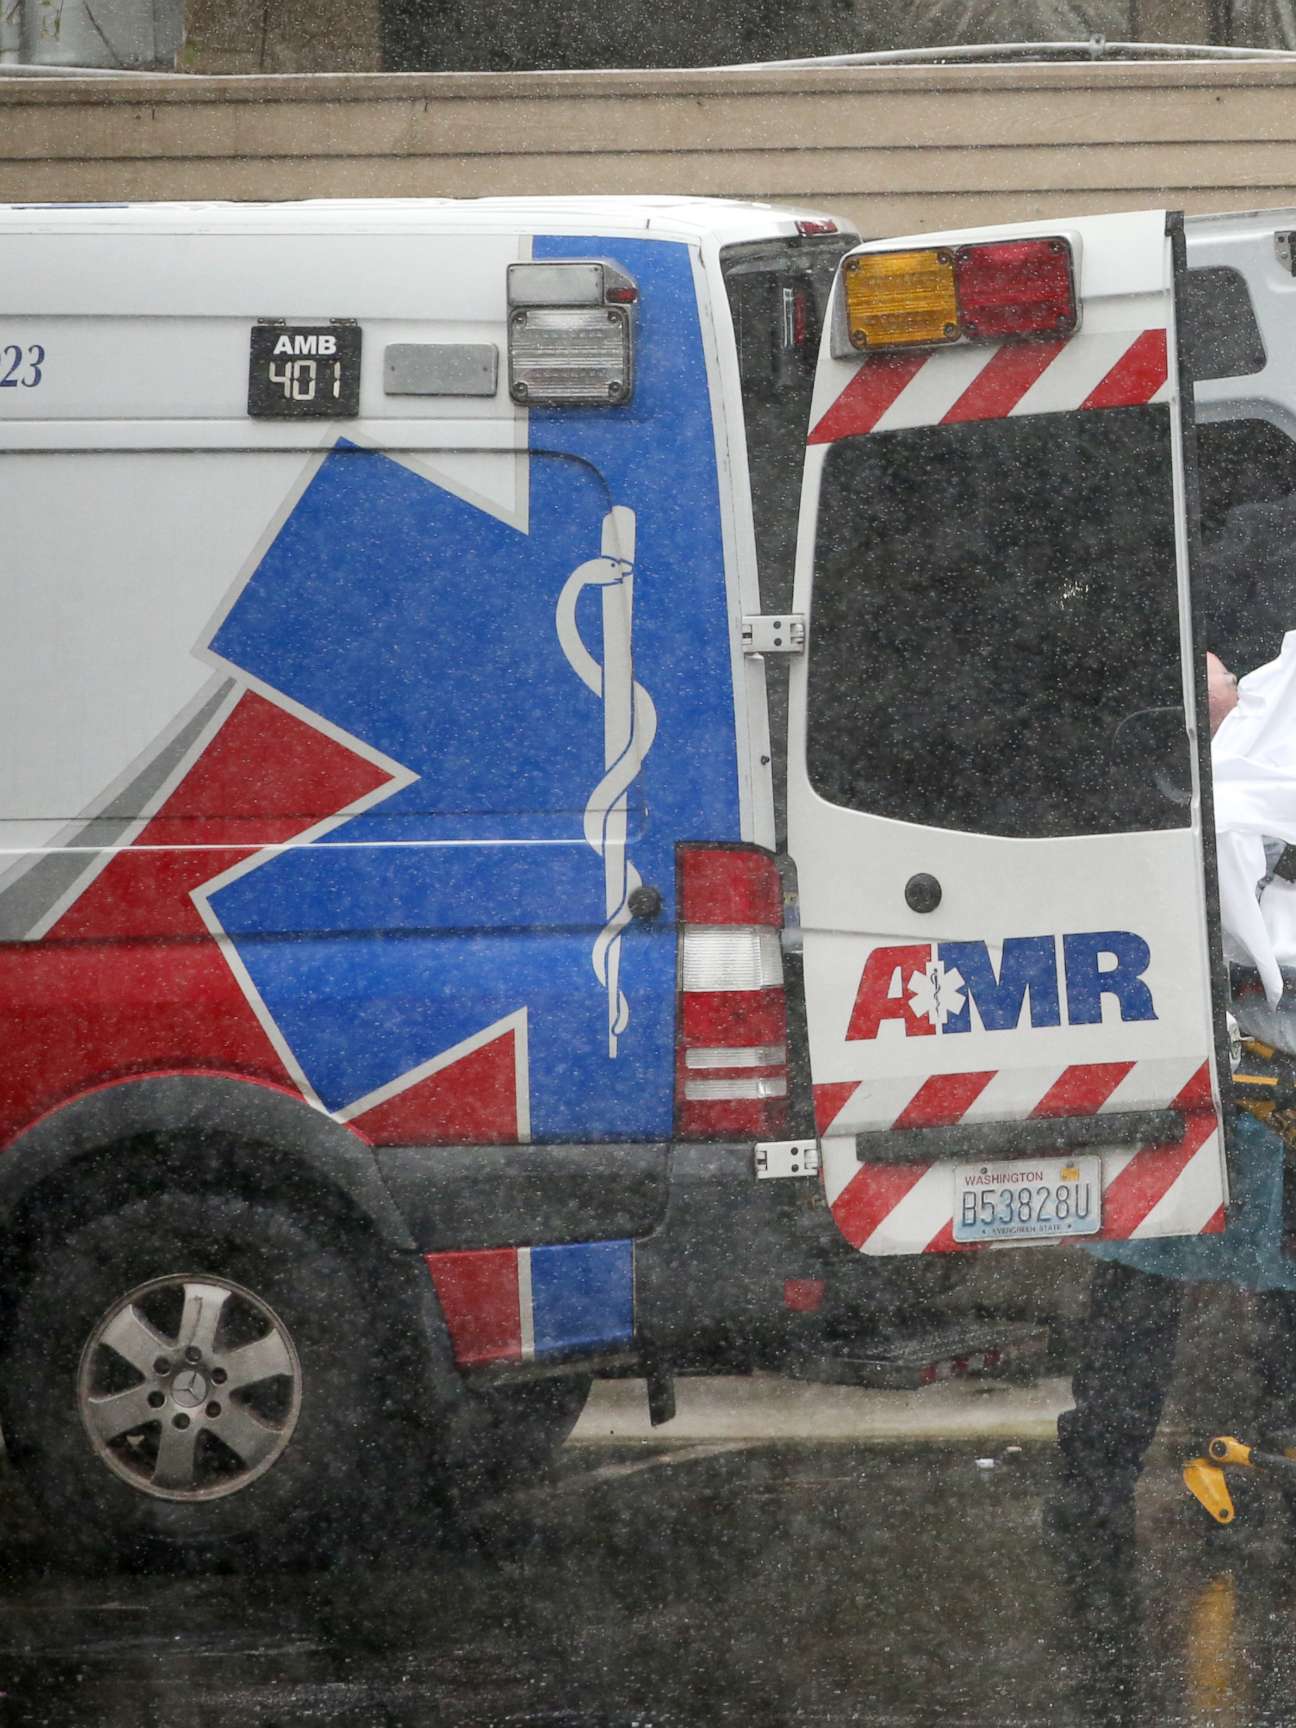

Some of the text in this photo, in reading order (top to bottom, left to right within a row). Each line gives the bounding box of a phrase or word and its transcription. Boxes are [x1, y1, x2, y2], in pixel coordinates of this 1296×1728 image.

[0, 344, 45, 388] 23
[273, 335, 337, 355] AMB
[269, 359, 341, 401] 401
[845, 930, 1159, 1042] AMR
[965, 1171, 1044, 1187] WASHINGTON
[962, 1183, 1089, 1228] B53828U
